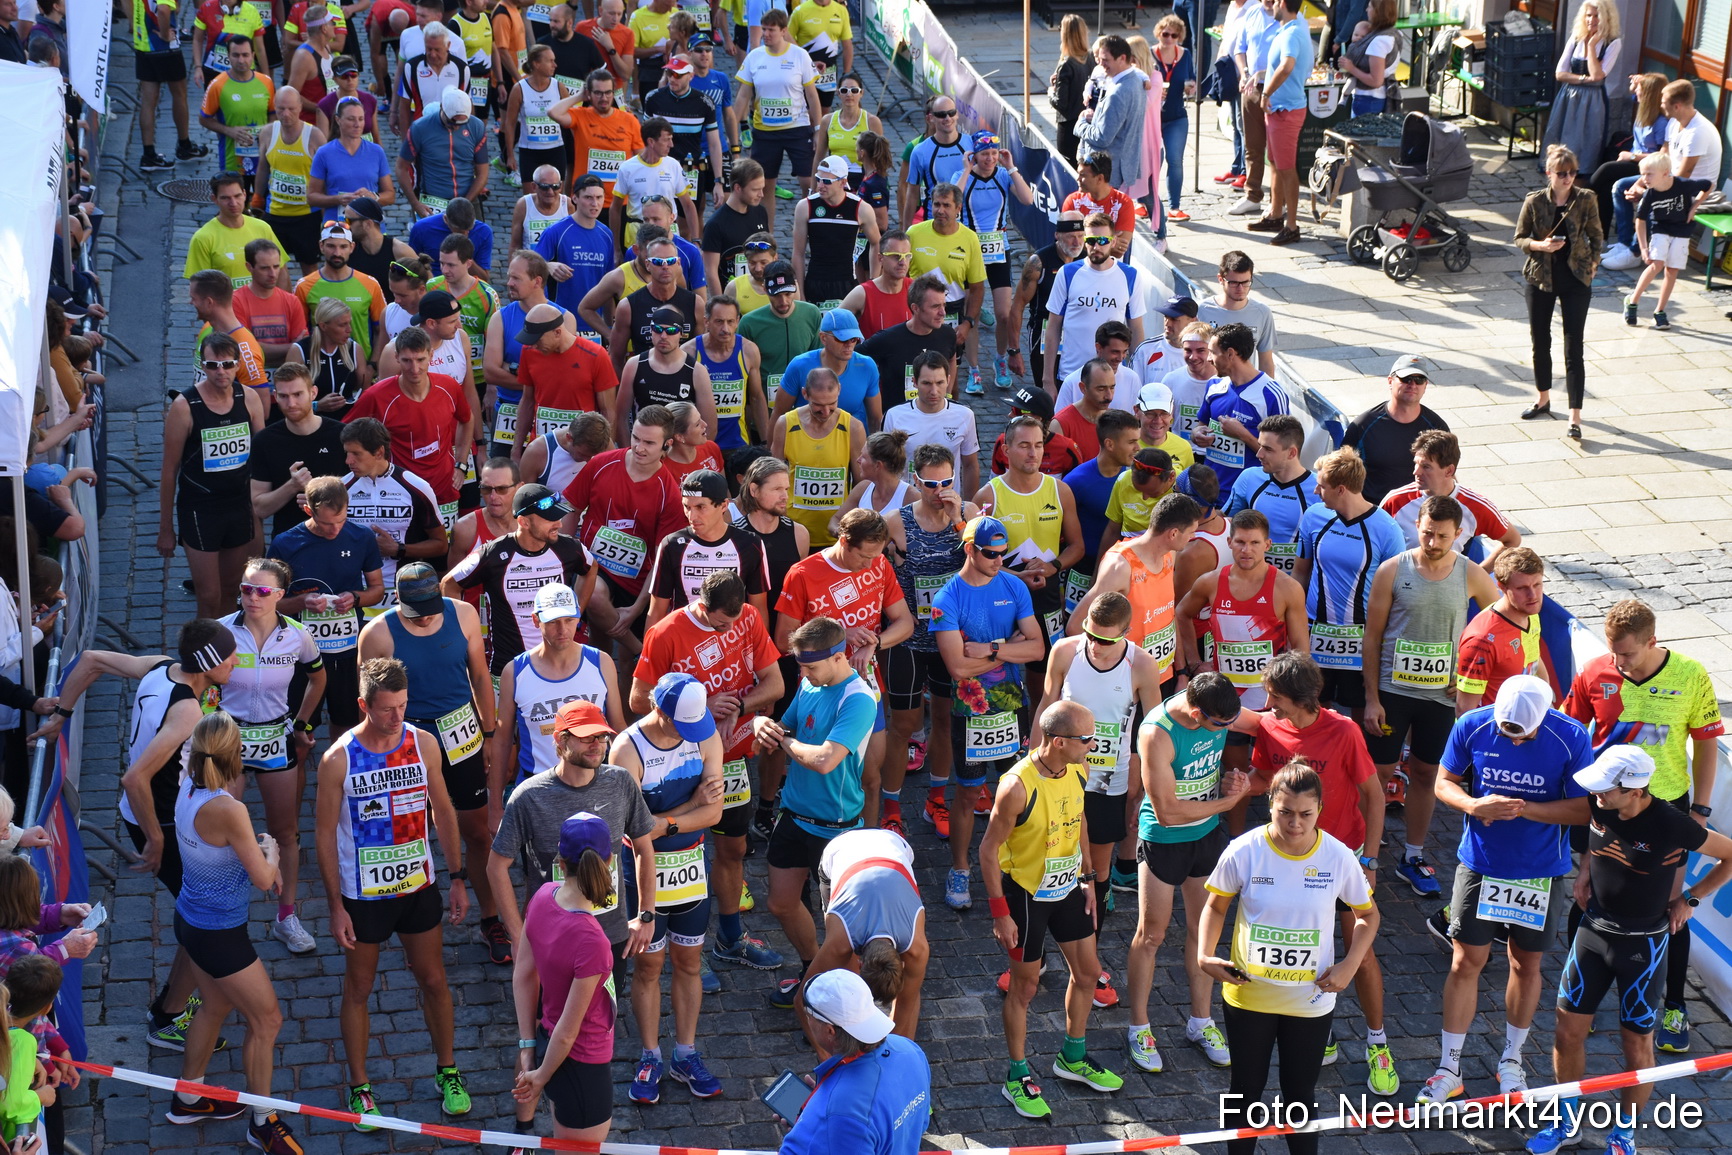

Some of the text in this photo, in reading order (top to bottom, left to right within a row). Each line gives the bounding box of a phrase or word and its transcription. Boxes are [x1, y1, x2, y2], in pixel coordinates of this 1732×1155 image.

[764, 107, 790, 118] 2739
[530, 125, 556, 135] 2183
[592, 160, 620, 171] 2844
[275, 181, 302, 195] 1063
[980, 242, 1001, 254] 637
[572, 251, 605, 262] SYSCAD
[238, 342, 261, 381] BOCK
[713, 393, 739, 406] 344
[206, 425, 250, 443] BOCK
[209, 440, 248, 458] 2005
[218, 456, 241, 467] GÖTZ
[799, 469, 840, 481] BOCK
[801, 482, 839, 497] 1012
[802, 498, 835, 507] THOMAS
[603, 528, 645, 550] BOCK
[596, 540, 639, 567] 2573
[596, 556, 630, 575] PATRICK
[1216, 607, 1236, 615] Erlangen
[1220, 600, 1232, 608] LG
[308, 621, 353, 638] 2043
[1145, 626, 1175, 646] BOCK
[1316, 623, 1358, 637] BOCK
[317, 639, 349, 649] ÜRGEN
[1149, 636, 1175, 660] 1362
[1224, 644, 1267, 656] BOCK
[1315, 637, 1358, 654] 2435
[1401, 642, 1446, 655] BOCK
[1224, 656, 1267, 674] 1386
[1317, 656, 1354, 666] THOMAS
[1402, 656, 1445, 673] 1340
[1398, 673, 1444, 684] ALEXANDER
[443, 705, 472, 730] BOC
[530, 713, 557, 723] KALLMÜ
[972, 713, 1014, 728] BOCK
[449, 718, 477, 746] 116
[973, 726, 1015, 746] 2655
[240, 740, 280, 759] 2790
[975, 745, 1013, 758] RICHARD
[645, 756, 666, 766] ATSV
[1085, 756, 1106, 766] KUS
[352, 764, 424, 789] LA CARRERA
[1177, 775, 1217, 793] BOCK
[1482, 767, 1546, 787] SYSCAD
[353, 775, 425, 795] TRITEAM ROTHSEE
[724, 795, 742, 804] NIEL
[366, 843, 419, 863] BOCK
[655, 851, 698, 867] BOCK
[369, 860, 421, 884] 1085
[655, 865, 698, 888] 1400
[1047, 868, 1077, 889] 206
[1305, 868, 1317, 877] 20
[378, 880, 413, 895] DANIEL
[1488, 884, 1540, 910] 2144
[1487, 906, 1535, 922] ANDREAS
[673, 934, 701, 945] ATSV
[1256, 928, 1313, 943] BOCK
[1256, 946, 1312, 967] 1367
[1263, 968, 1306, 984] NANCY
